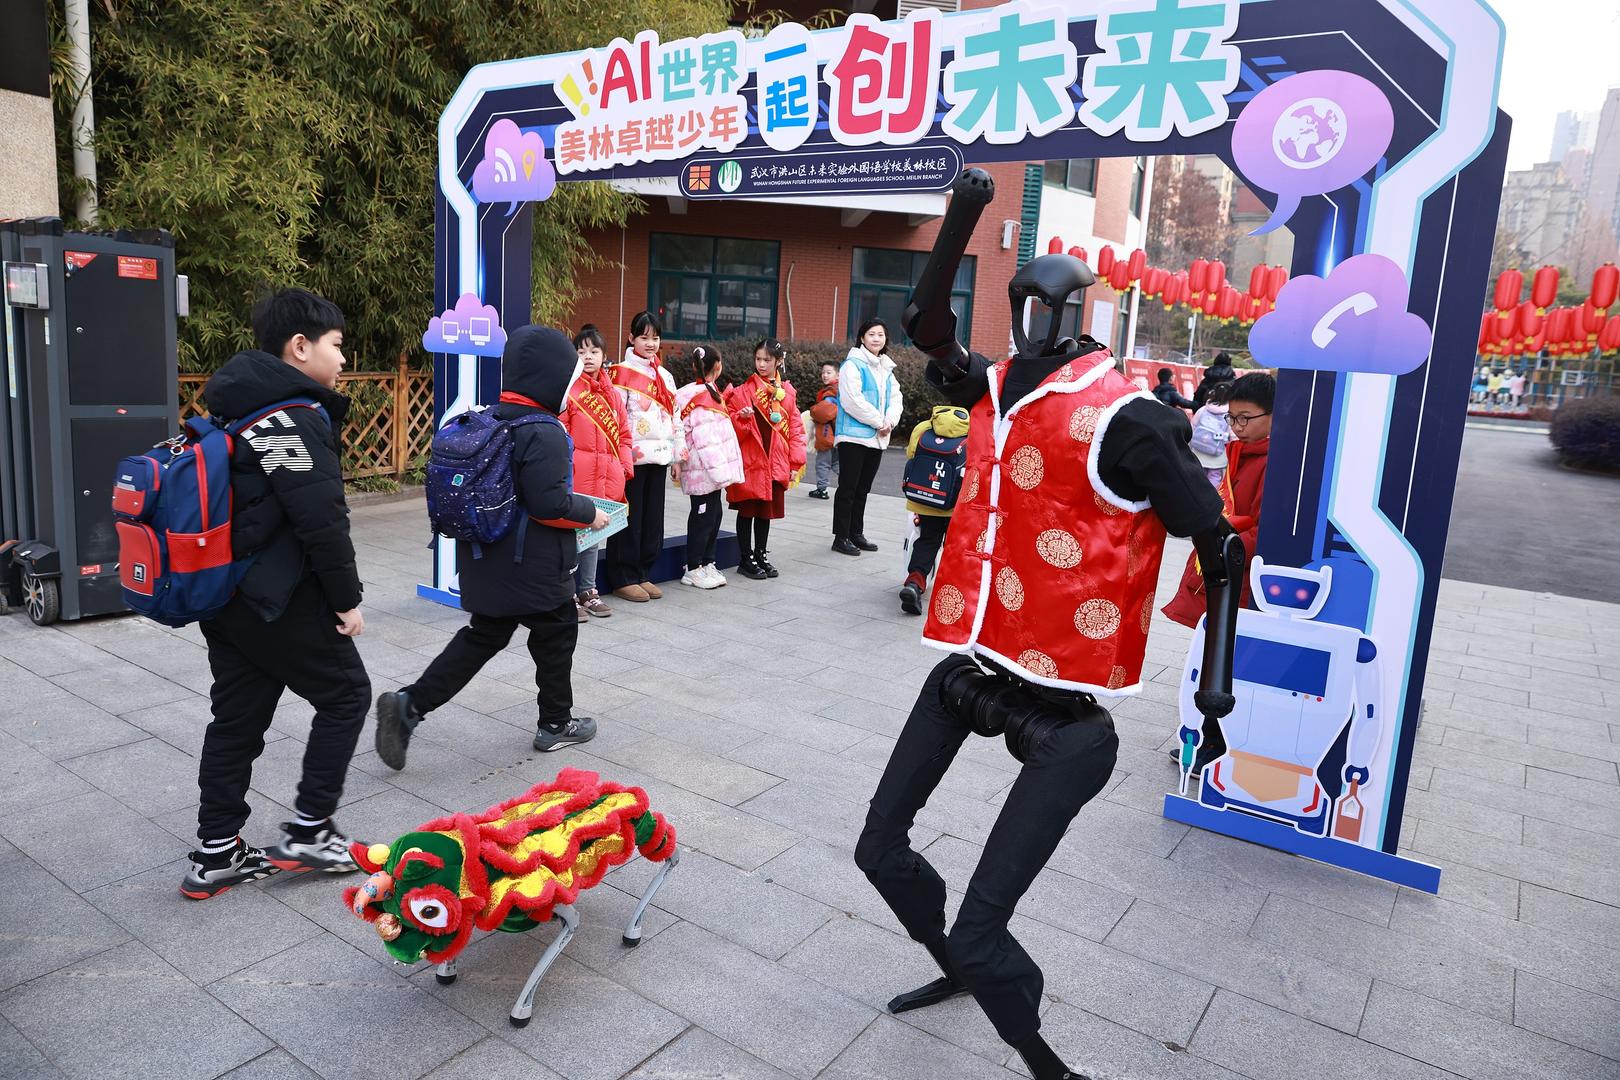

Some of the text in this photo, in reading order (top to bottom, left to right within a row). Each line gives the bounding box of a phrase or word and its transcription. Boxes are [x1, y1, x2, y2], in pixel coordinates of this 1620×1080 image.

[560, 105, 739, 165] 美林卓越少年
